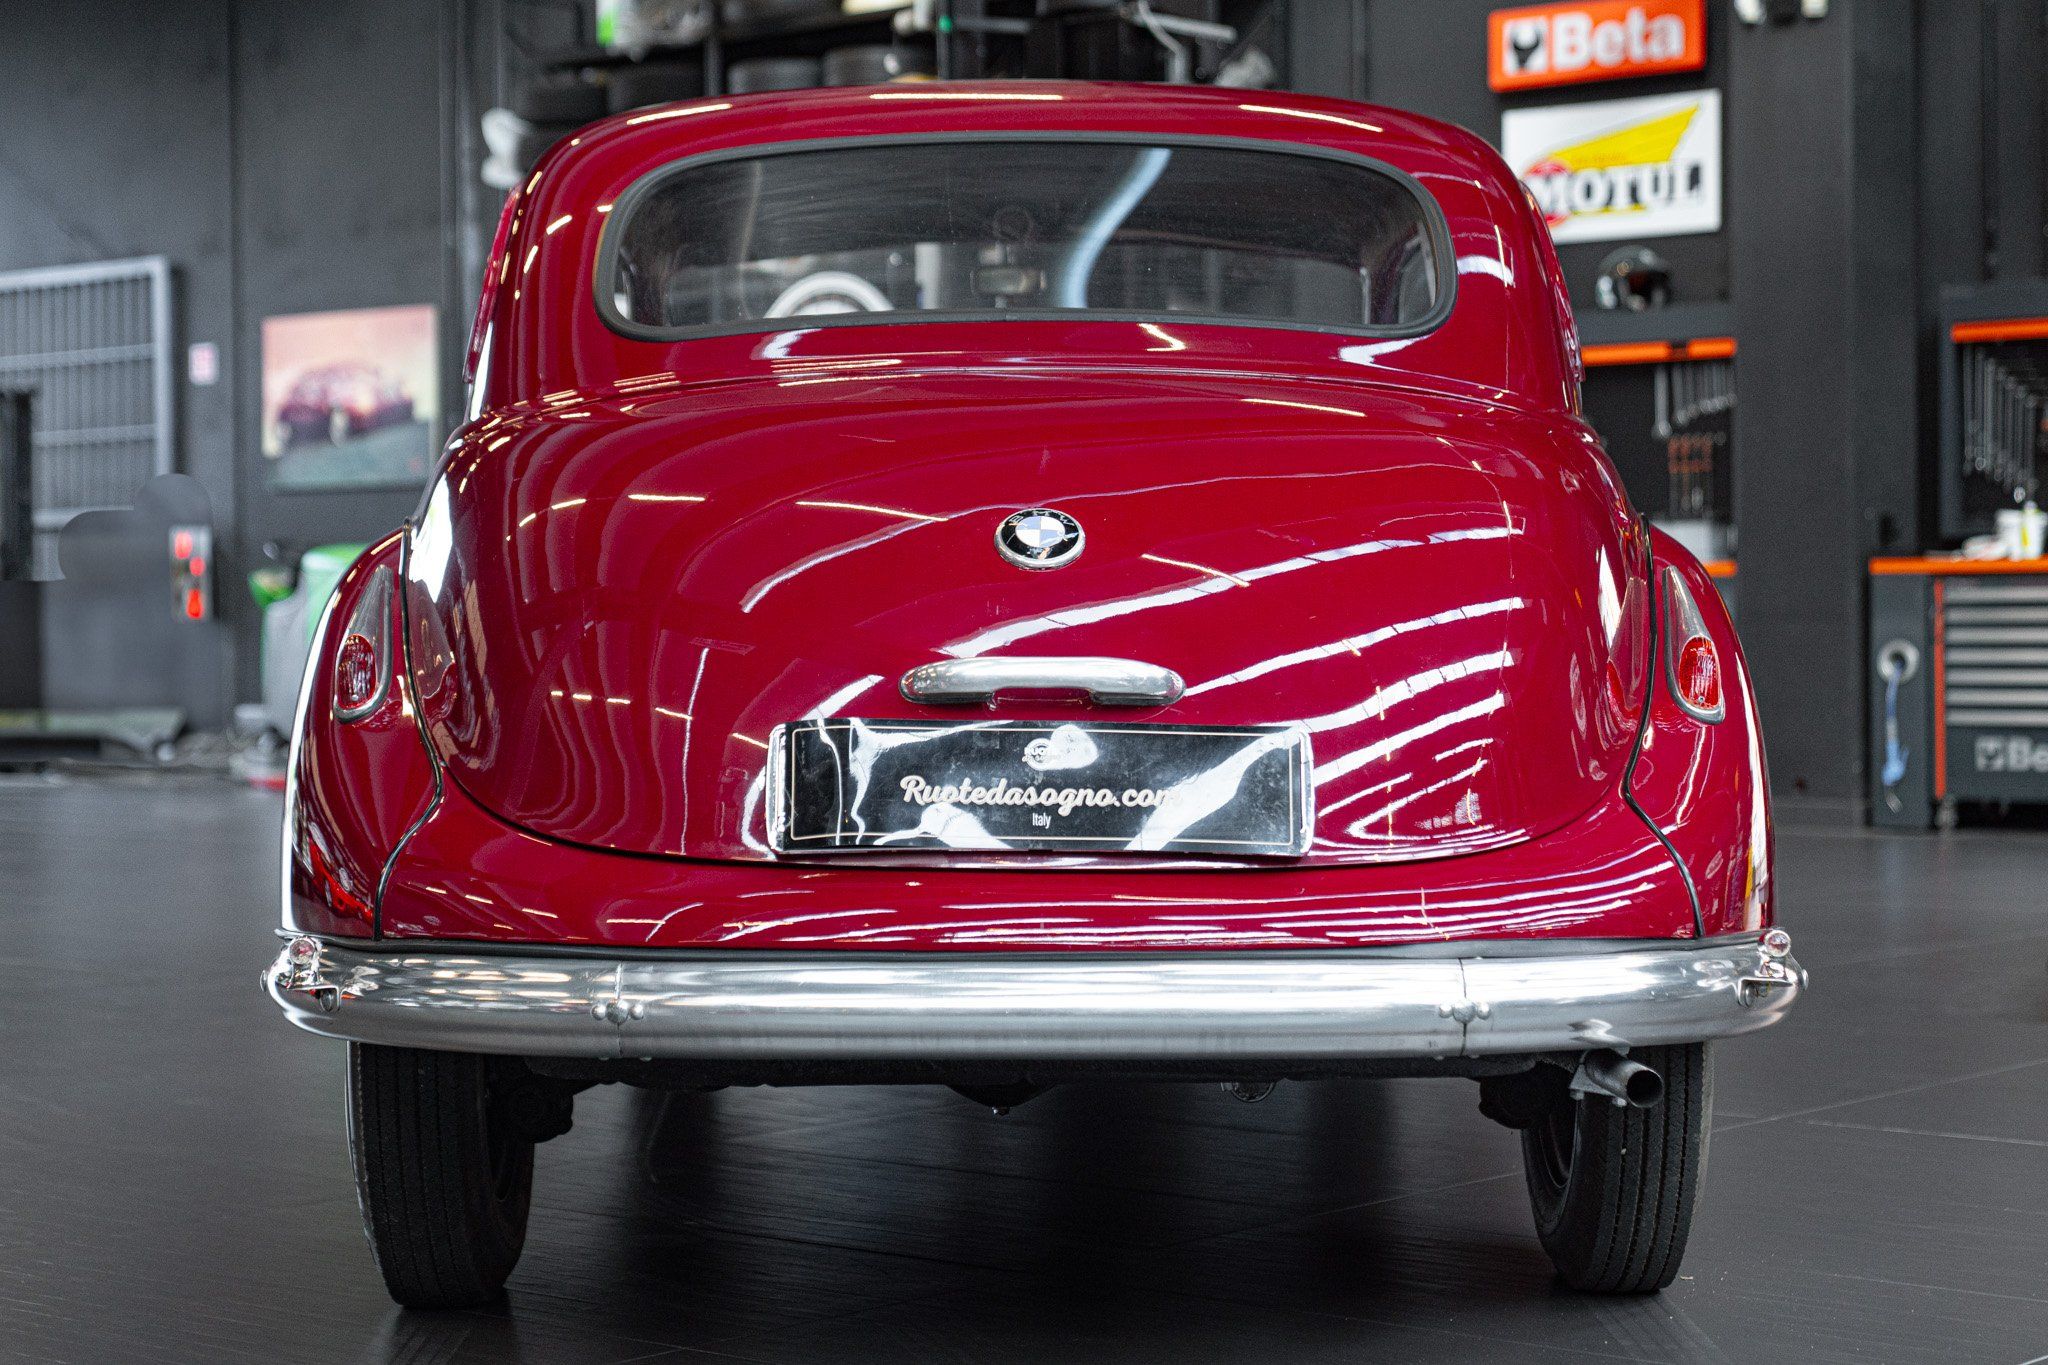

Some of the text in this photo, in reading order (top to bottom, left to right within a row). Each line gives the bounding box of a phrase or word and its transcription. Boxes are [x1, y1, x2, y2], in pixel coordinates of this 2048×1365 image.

[1553, 7, 1685, 69] Beta
[1007, 509, 1076, 526] BMW
[1032, 812, 1051, 829] Italy
